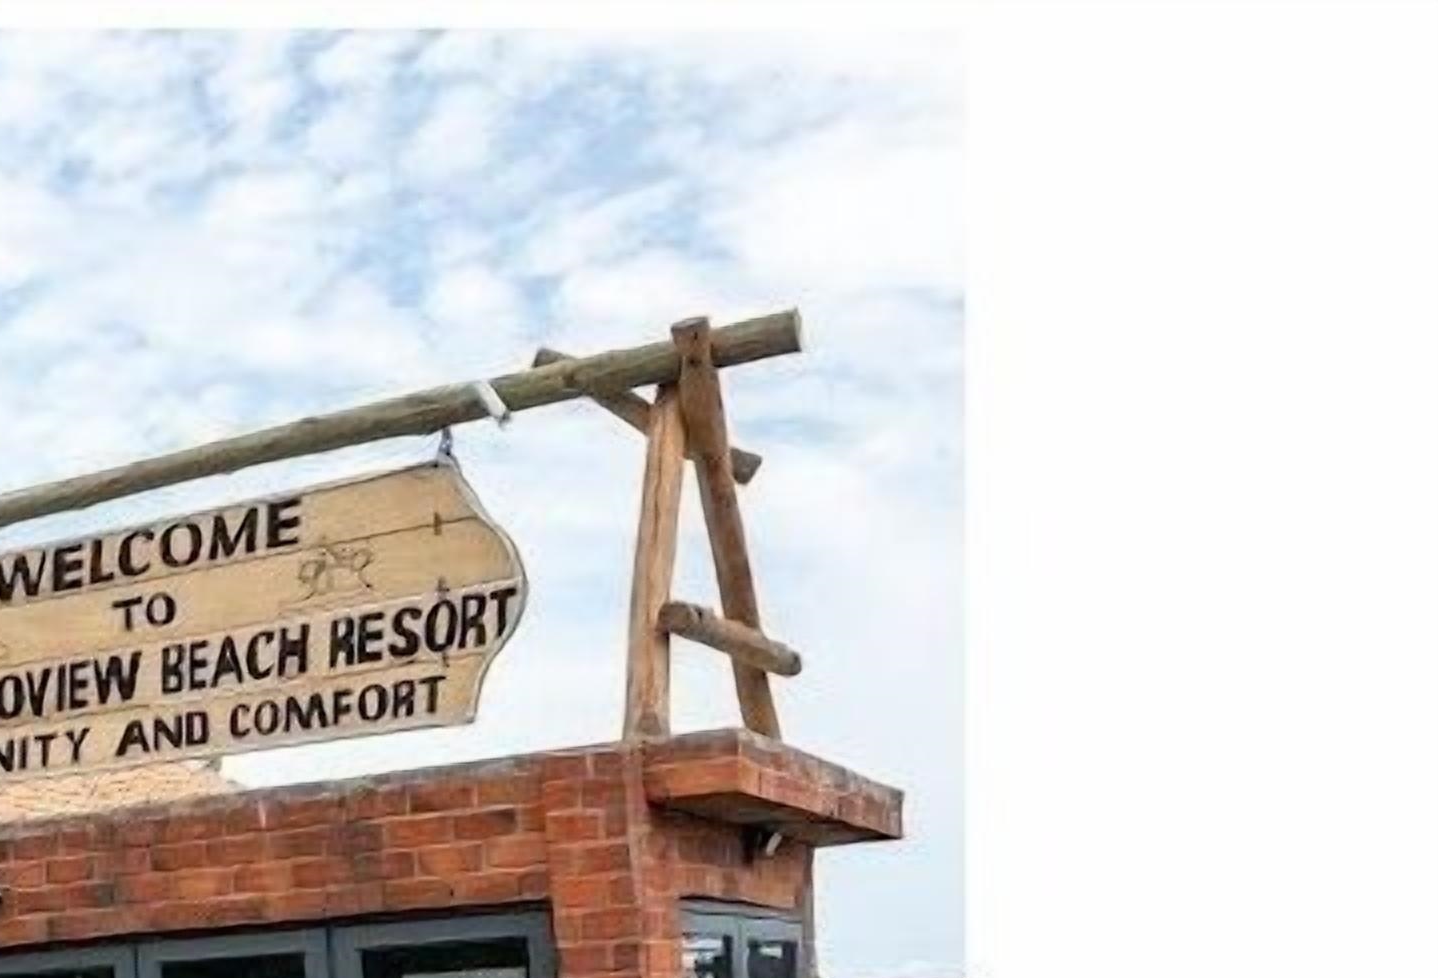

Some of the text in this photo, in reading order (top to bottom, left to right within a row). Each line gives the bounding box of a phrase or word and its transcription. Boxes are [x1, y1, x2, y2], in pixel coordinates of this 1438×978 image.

[110, 592, 177, 632] TO
[162, 624, 309, 694] BEACH
[329, 589, 517, 668] RESORT
[115, 711, 210, 757] AND
[229, 676, 447, 737] COMFORT
